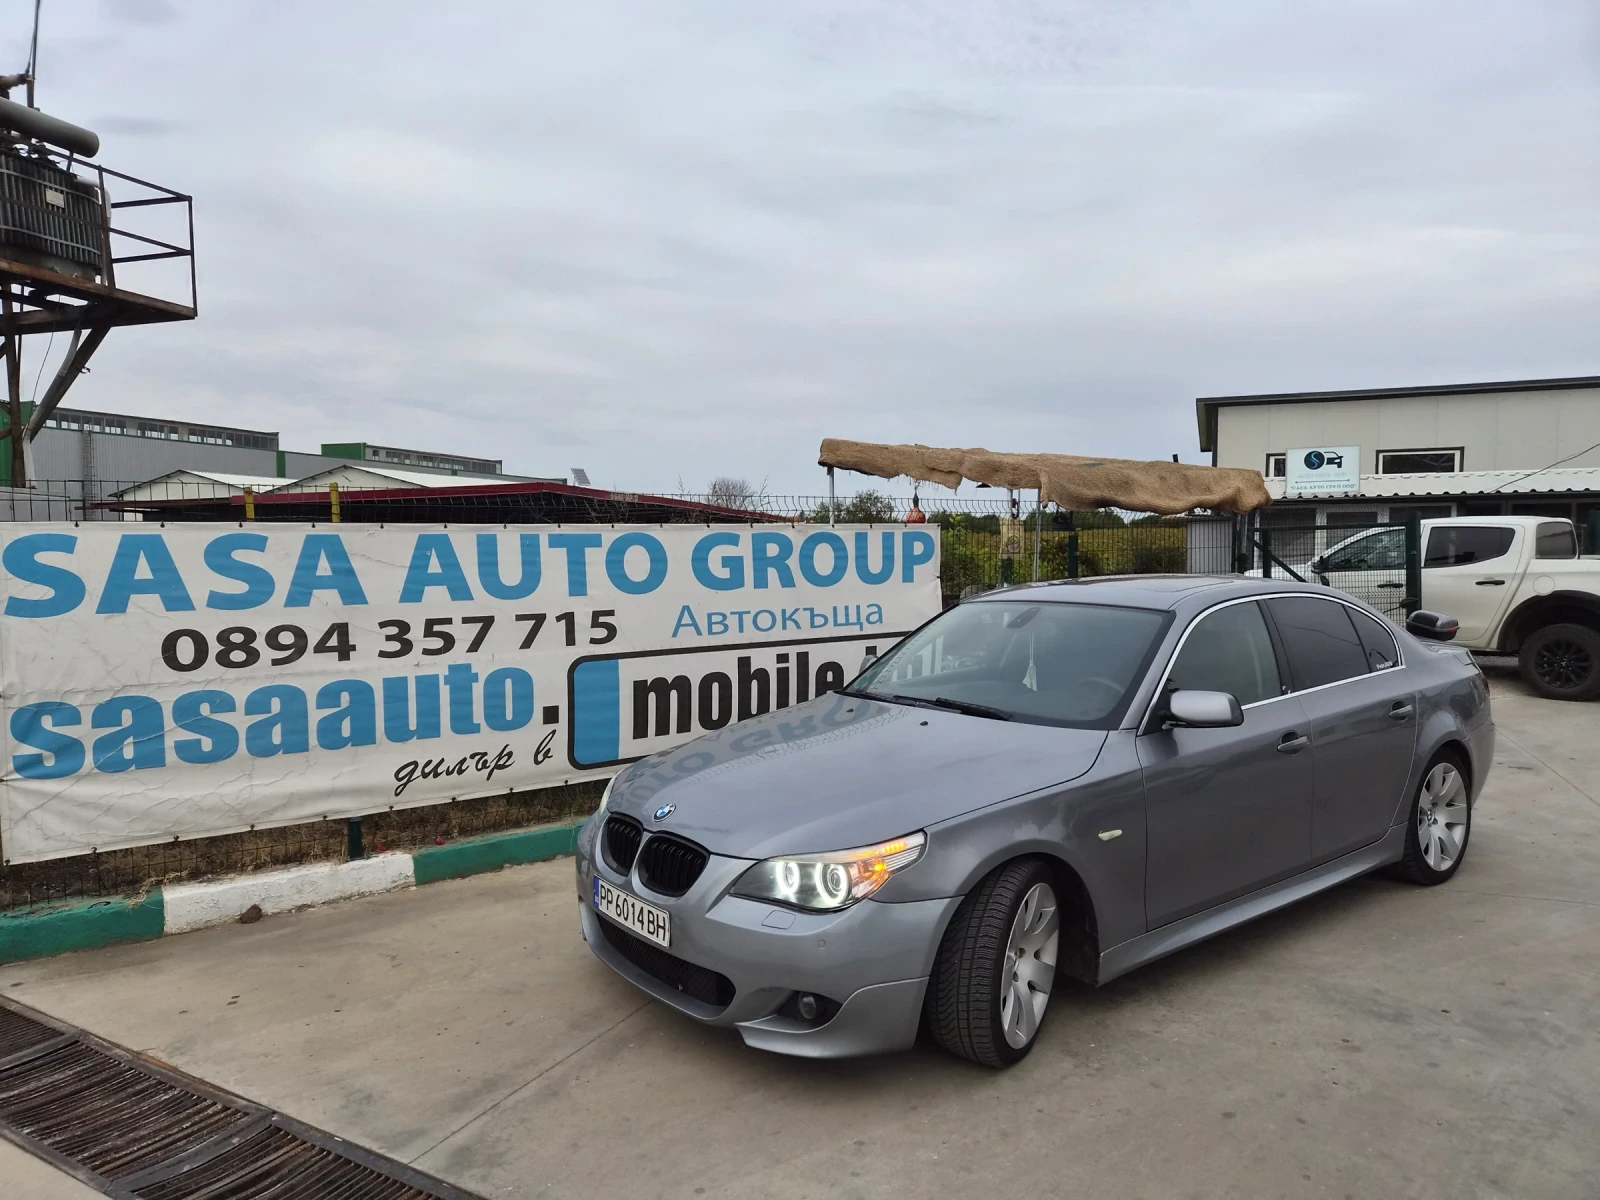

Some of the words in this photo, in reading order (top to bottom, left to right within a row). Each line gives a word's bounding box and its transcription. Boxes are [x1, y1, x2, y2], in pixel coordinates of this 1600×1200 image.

[2, 532, 369, 618] SASA
[398, 532, 669, 603] AUTO
[691, 530, 935, 592] GROUP
[161, 621, 357, 672] 0894
[377, 615, 496, 659] 357
[515, 609, 618, 650] 715
[671, 602, 884, 638] Автокъща
[394, 743, 516, 797] дилър
[533, 729, 557, 766] в
[600, 883, 667, 942] PP6014BH
